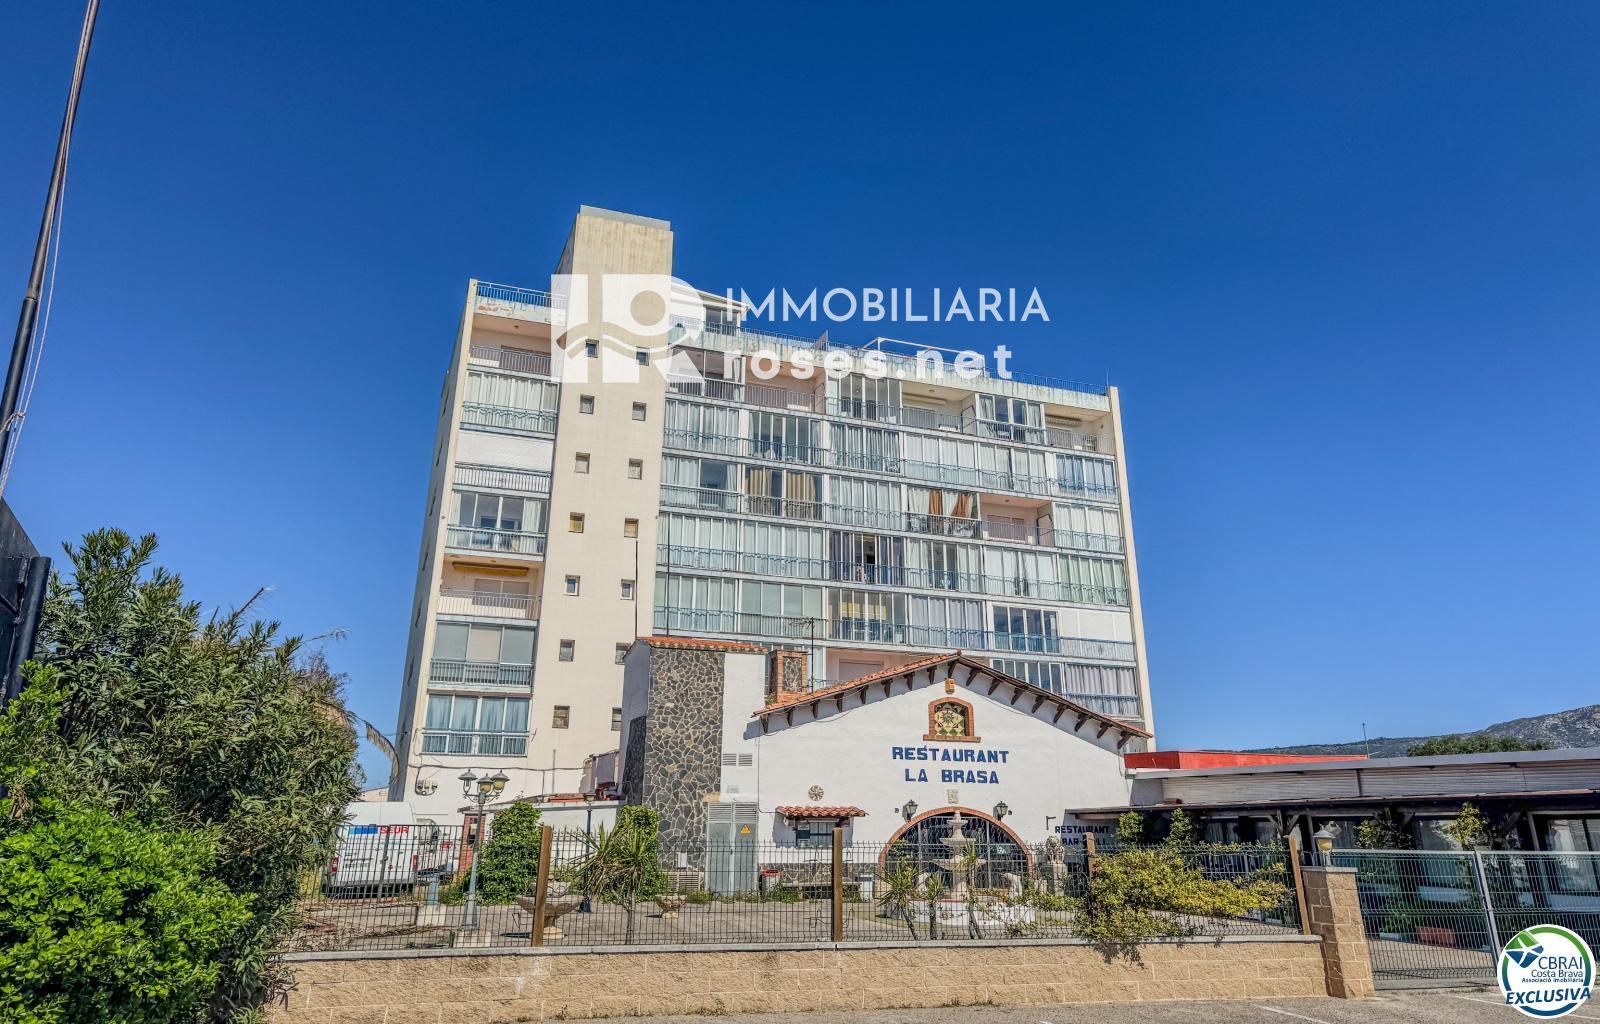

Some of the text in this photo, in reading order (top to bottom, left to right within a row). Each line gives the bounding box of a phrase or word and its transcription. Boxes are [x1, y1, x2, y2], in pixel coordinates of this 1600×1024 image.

[892, 746, 1009, 764] RESTAURANT
[904, 768, 1000, 785] LA BRASA
[380, 825, 409, 834] SEUR
[1055, 825, 1110, 834] RESTAURANT
[1062, 838, 1079, 846] BAR
